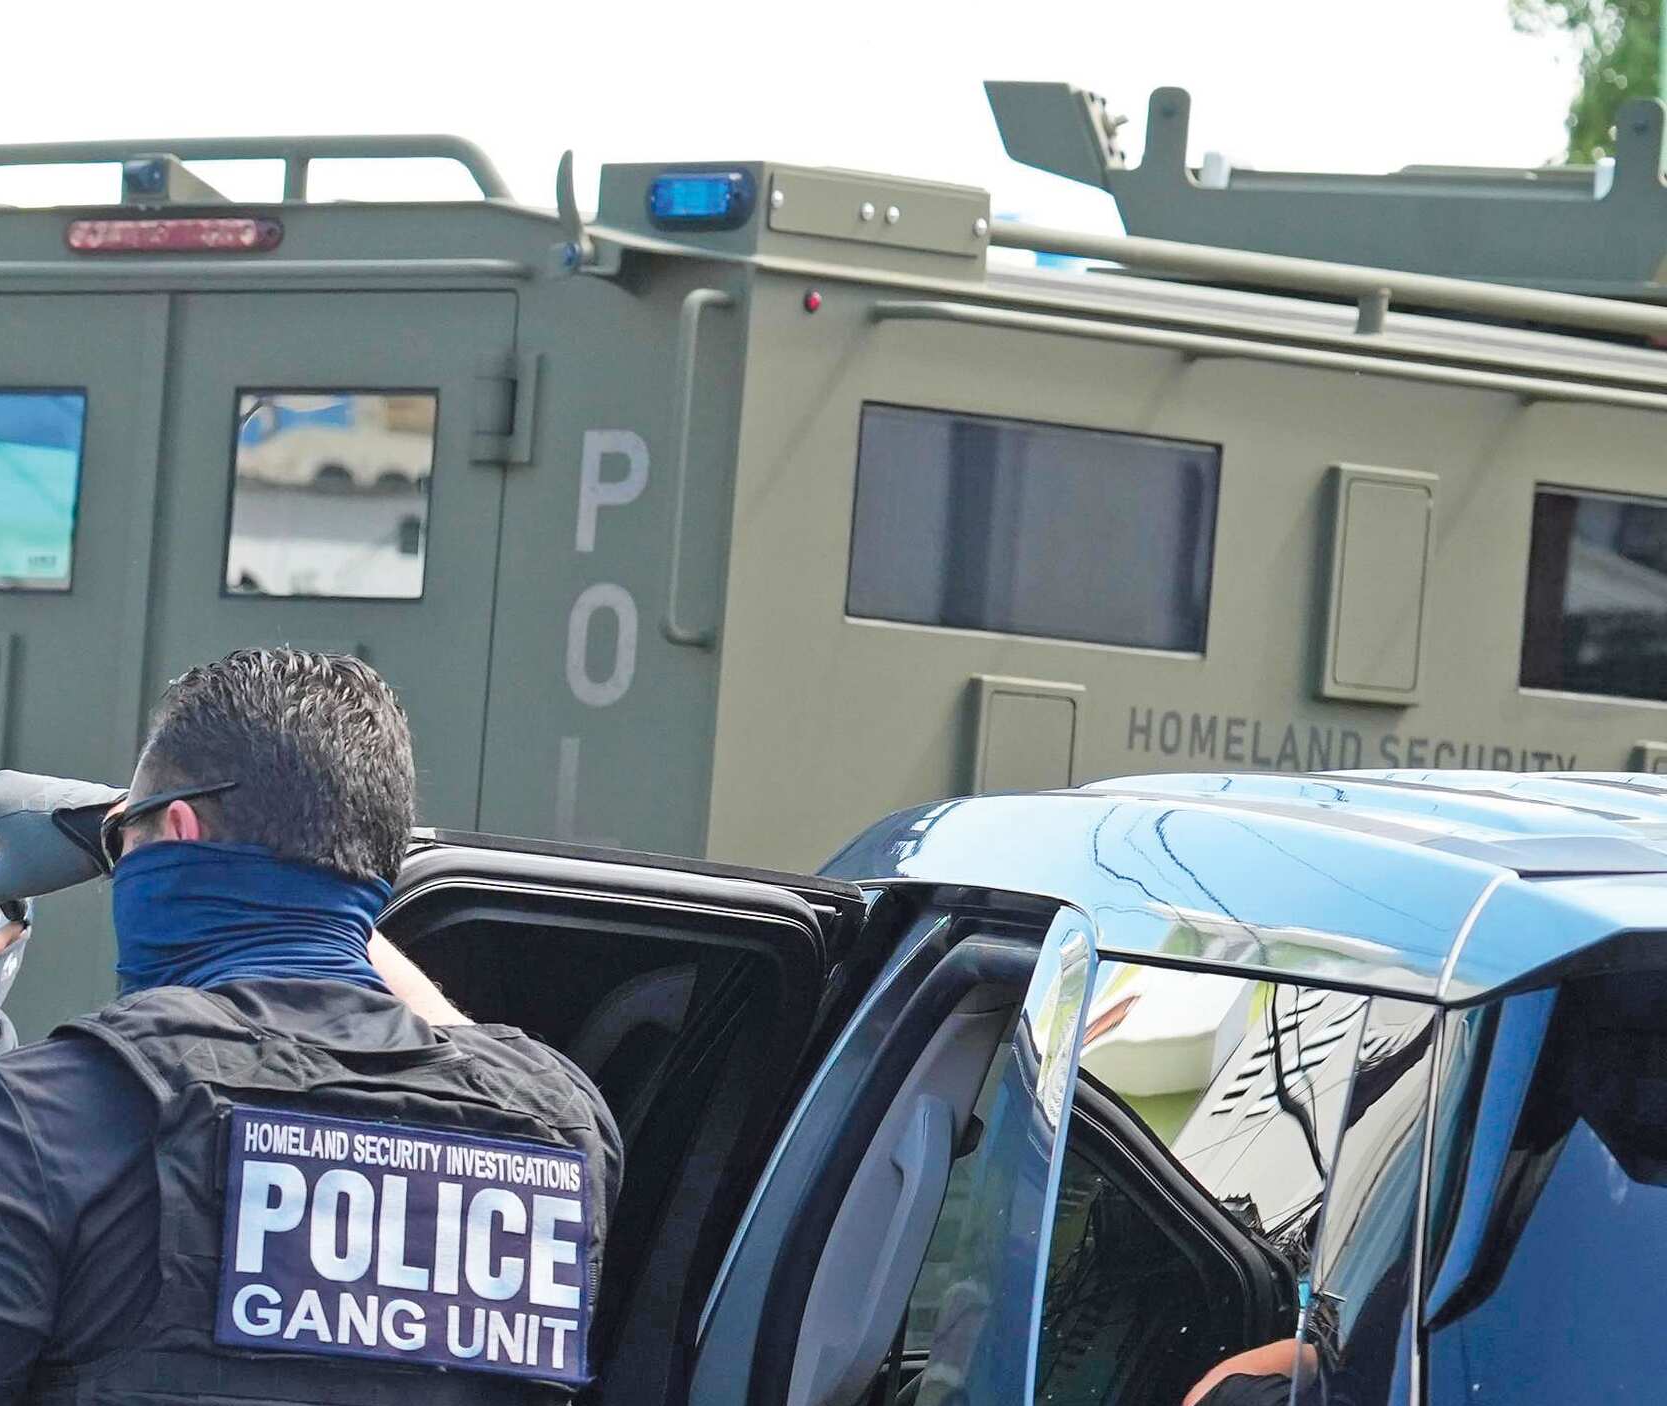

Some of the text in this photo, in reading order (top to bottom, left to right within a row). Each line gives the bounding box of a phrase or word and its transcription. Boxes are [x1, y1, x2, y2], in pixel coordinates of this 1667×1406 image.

[1127, 706, 1363, 771] HOMELAND
[244, 1121, 582, 1192] HOMELAND SECURITY INVESTIGATIONS
[235, 1159, 583, 1310] POLICE
[231, 1283, 579, 1369] GANG UNIT
